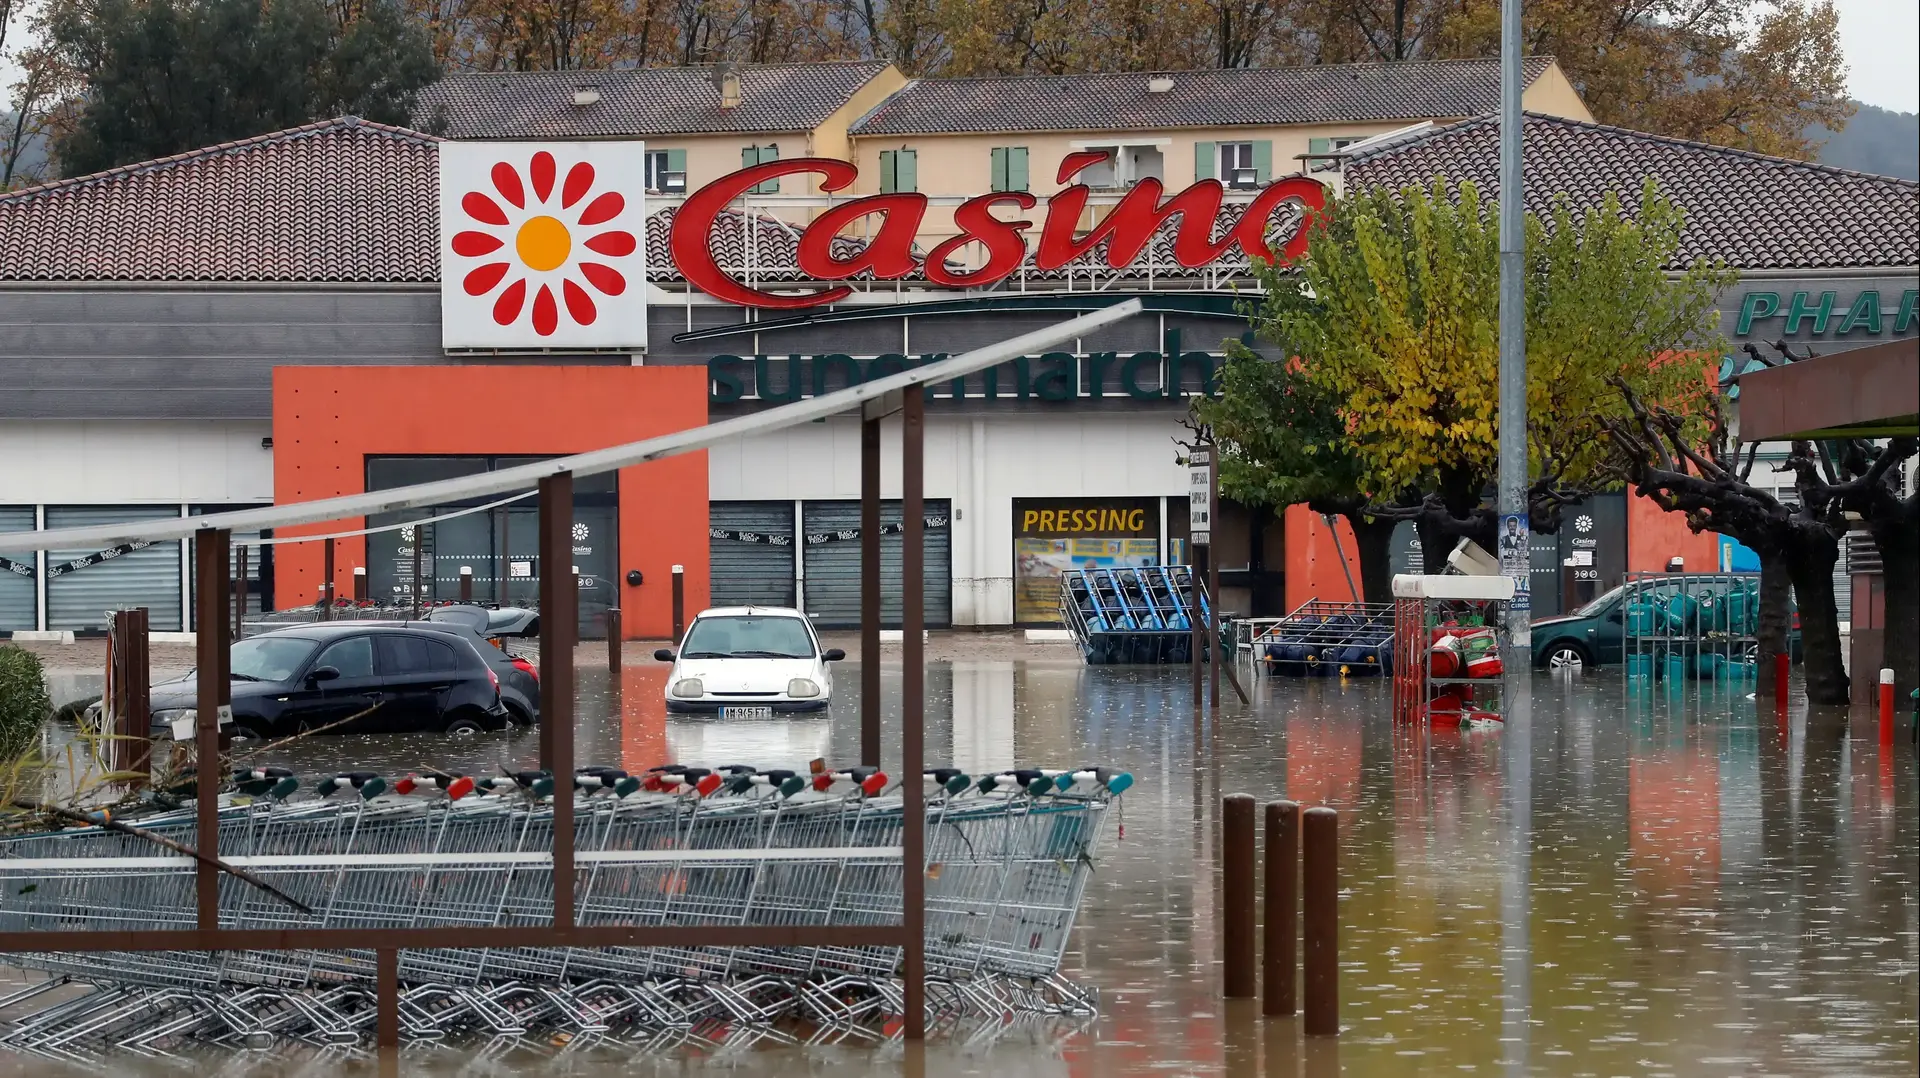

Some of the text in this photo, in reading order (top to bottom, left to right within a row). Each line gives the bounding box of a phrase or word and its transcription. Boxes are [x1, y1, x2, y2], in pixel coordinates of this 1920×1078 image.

[669, 150, 1336, 309] Casino
[707, 326, 1255, 422] suprmarch
[1023, 509, 1144, 532] PRESSING
